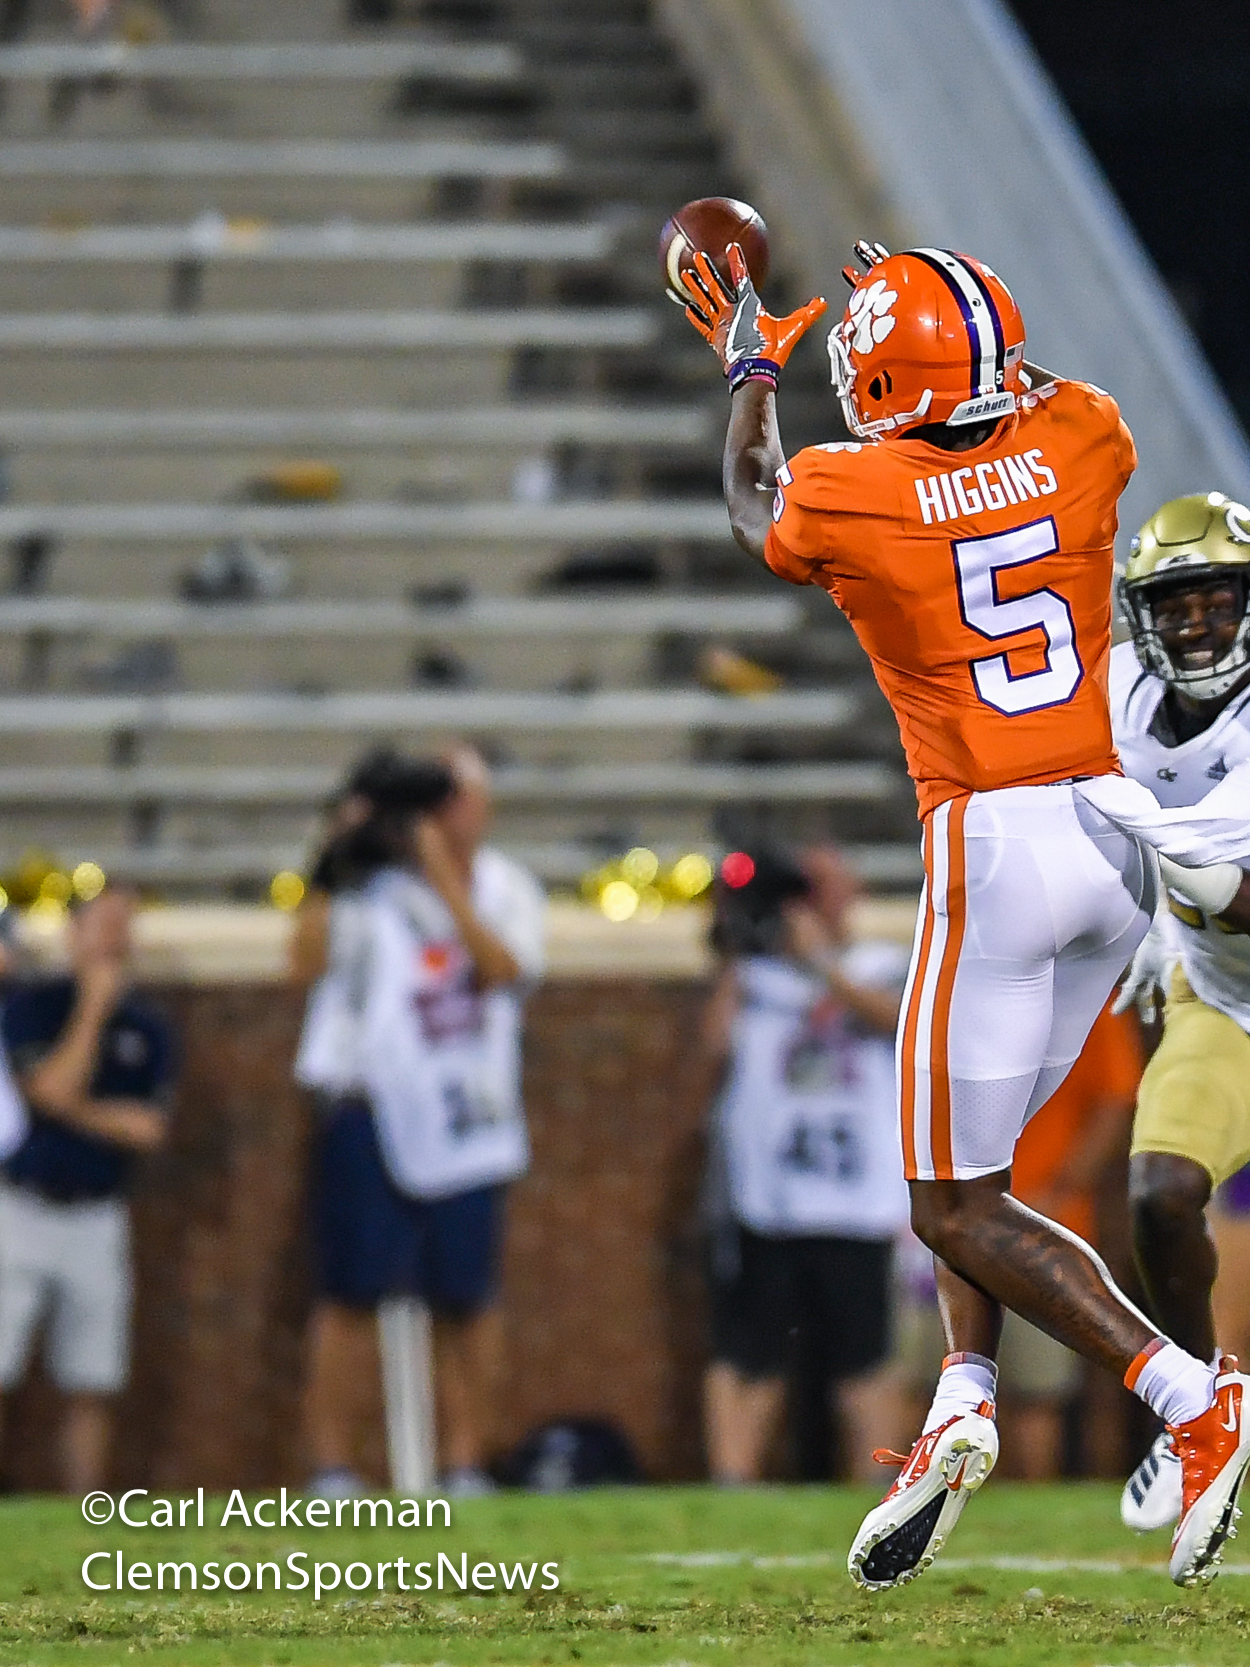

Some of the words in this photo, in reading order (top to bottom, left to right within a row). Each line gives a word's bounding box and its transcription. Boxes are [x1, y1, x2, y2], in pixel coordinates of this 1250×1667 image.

[995, 369, 1004, 385] 5
[966, 397, 1009, 416] schutt
[914, 448, 1058, 525] HIGGINS
[951, 514, 1084, 717] 5
